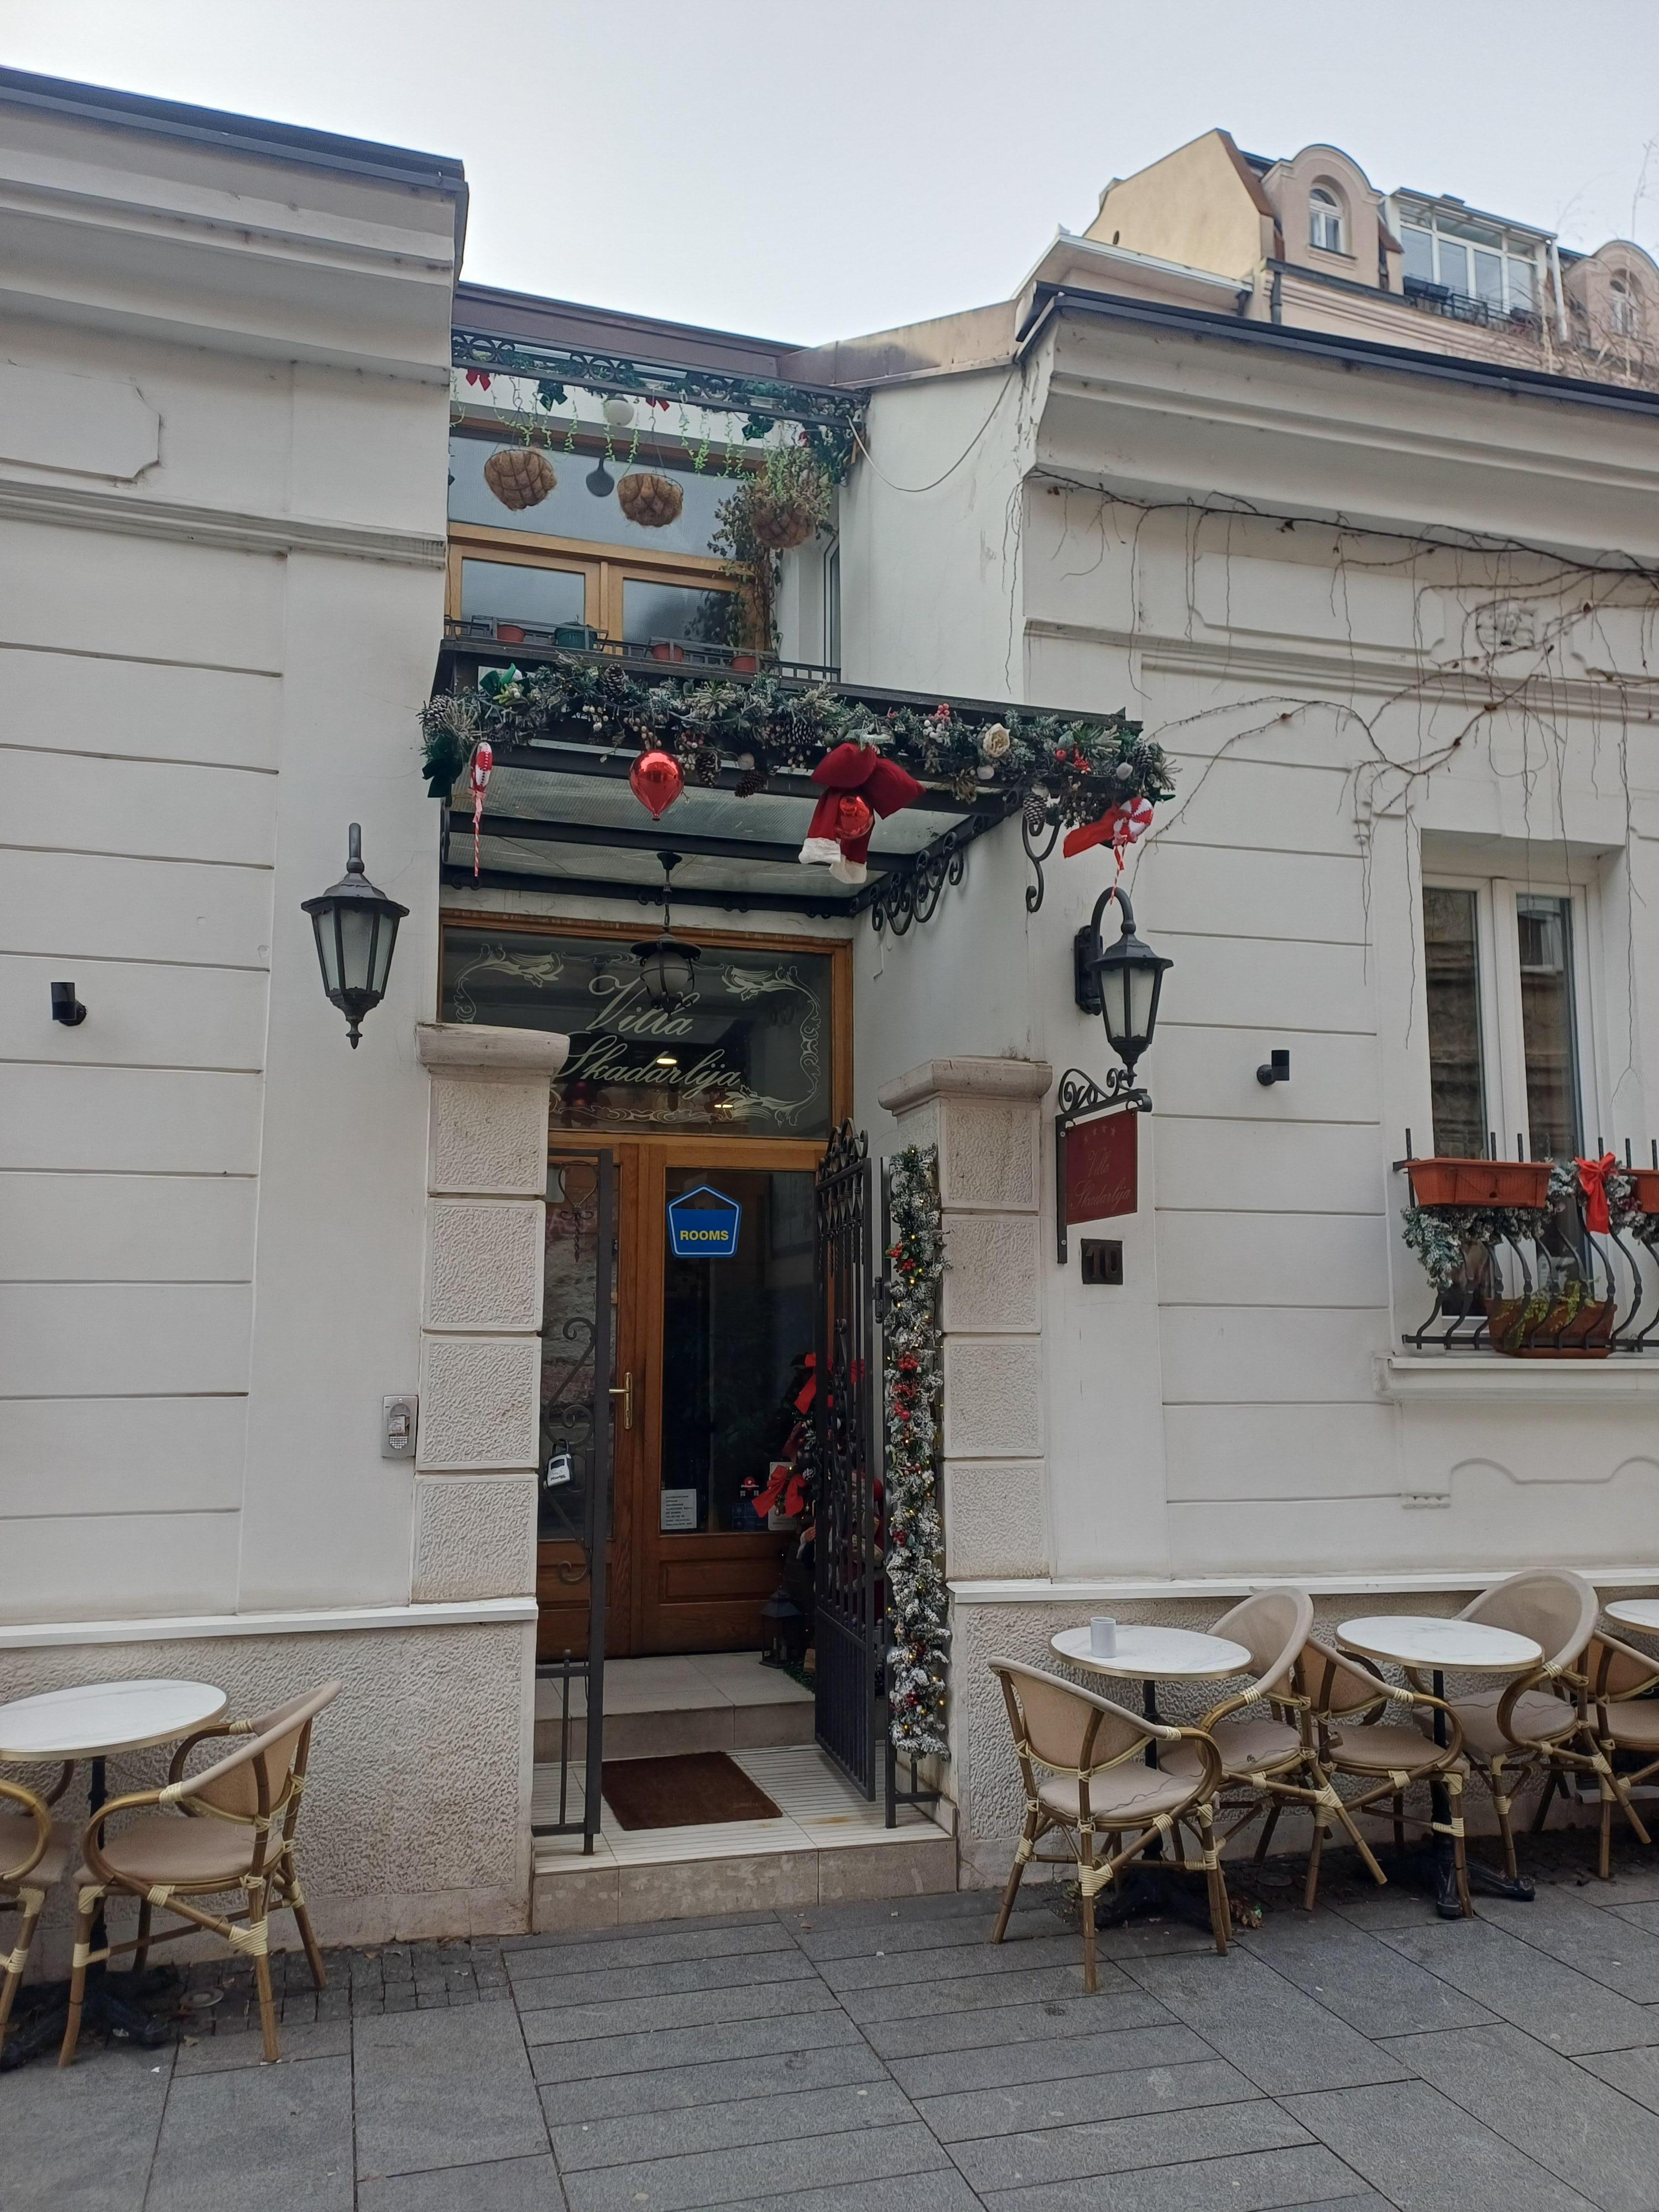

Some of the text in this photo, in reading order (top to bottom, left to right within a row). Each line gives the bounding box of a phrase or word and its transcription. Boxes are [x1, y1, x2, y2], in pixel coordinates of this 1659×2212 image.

[585, 975, 700, 1035] Villa
[554, 1031, 741, 1099] Skadarlija
[1071, 1177, 1132, 1212] Skadarlija
[680, 1230, 729, 1240] ROOMS
[1086, 1245, 1121, 1278] 10
